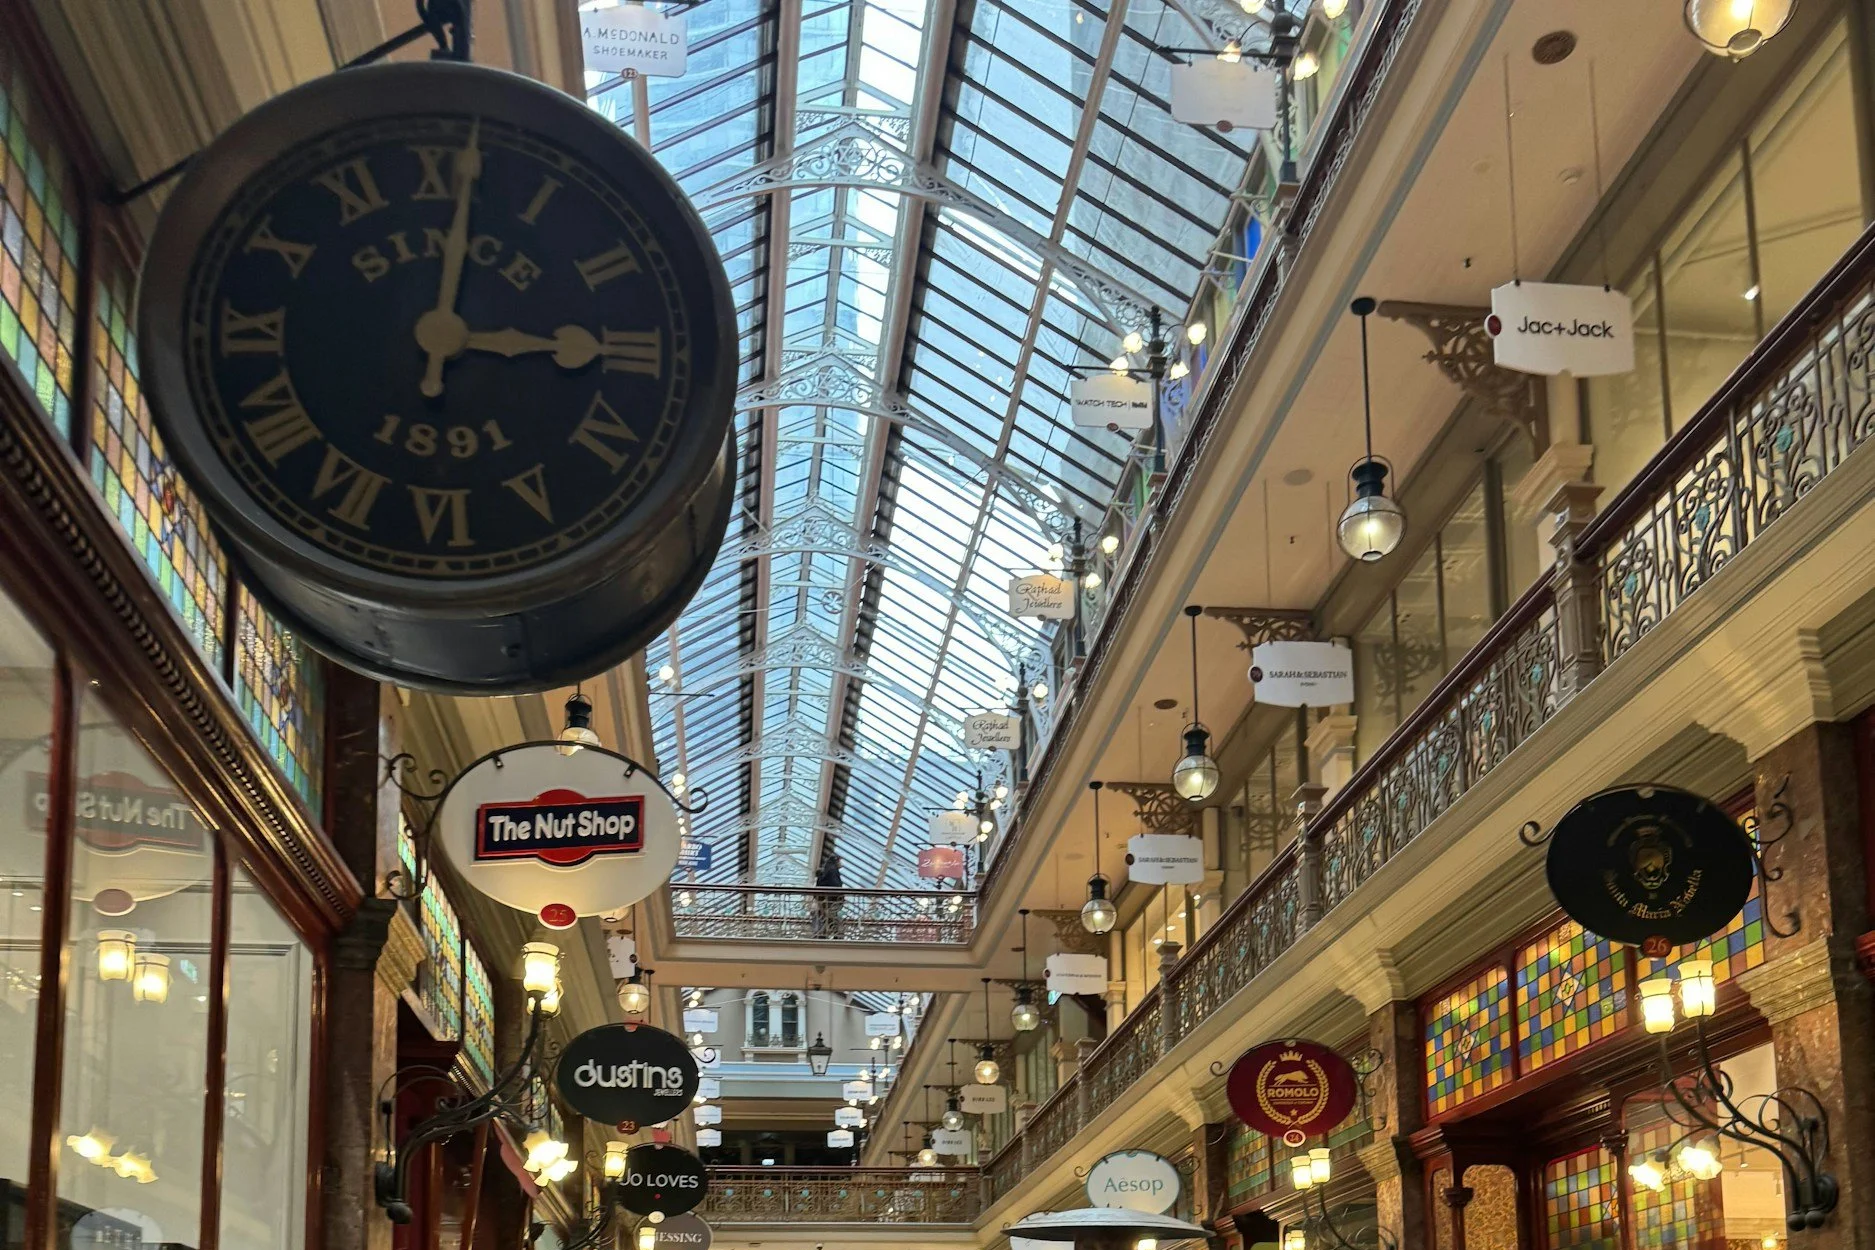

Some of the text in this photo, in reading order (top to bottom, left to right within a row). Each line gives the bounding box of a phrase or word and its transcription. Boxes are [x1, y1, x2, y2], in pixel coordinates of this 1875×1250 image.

[593, 45, 668, 60] SHOEMAKER
[373, 414, 512, 459] 1891
[488, 810, 635, 842] The Nut Shop
[1648, 938, 1667, 953] 26
[573, 1058, 684, 1089] dustins
[1268, 1087, 1319, 1098] ROMOLO
[621, 1120, 635, 1131] 23
[646, 1174, 699, 1189] LOVES
